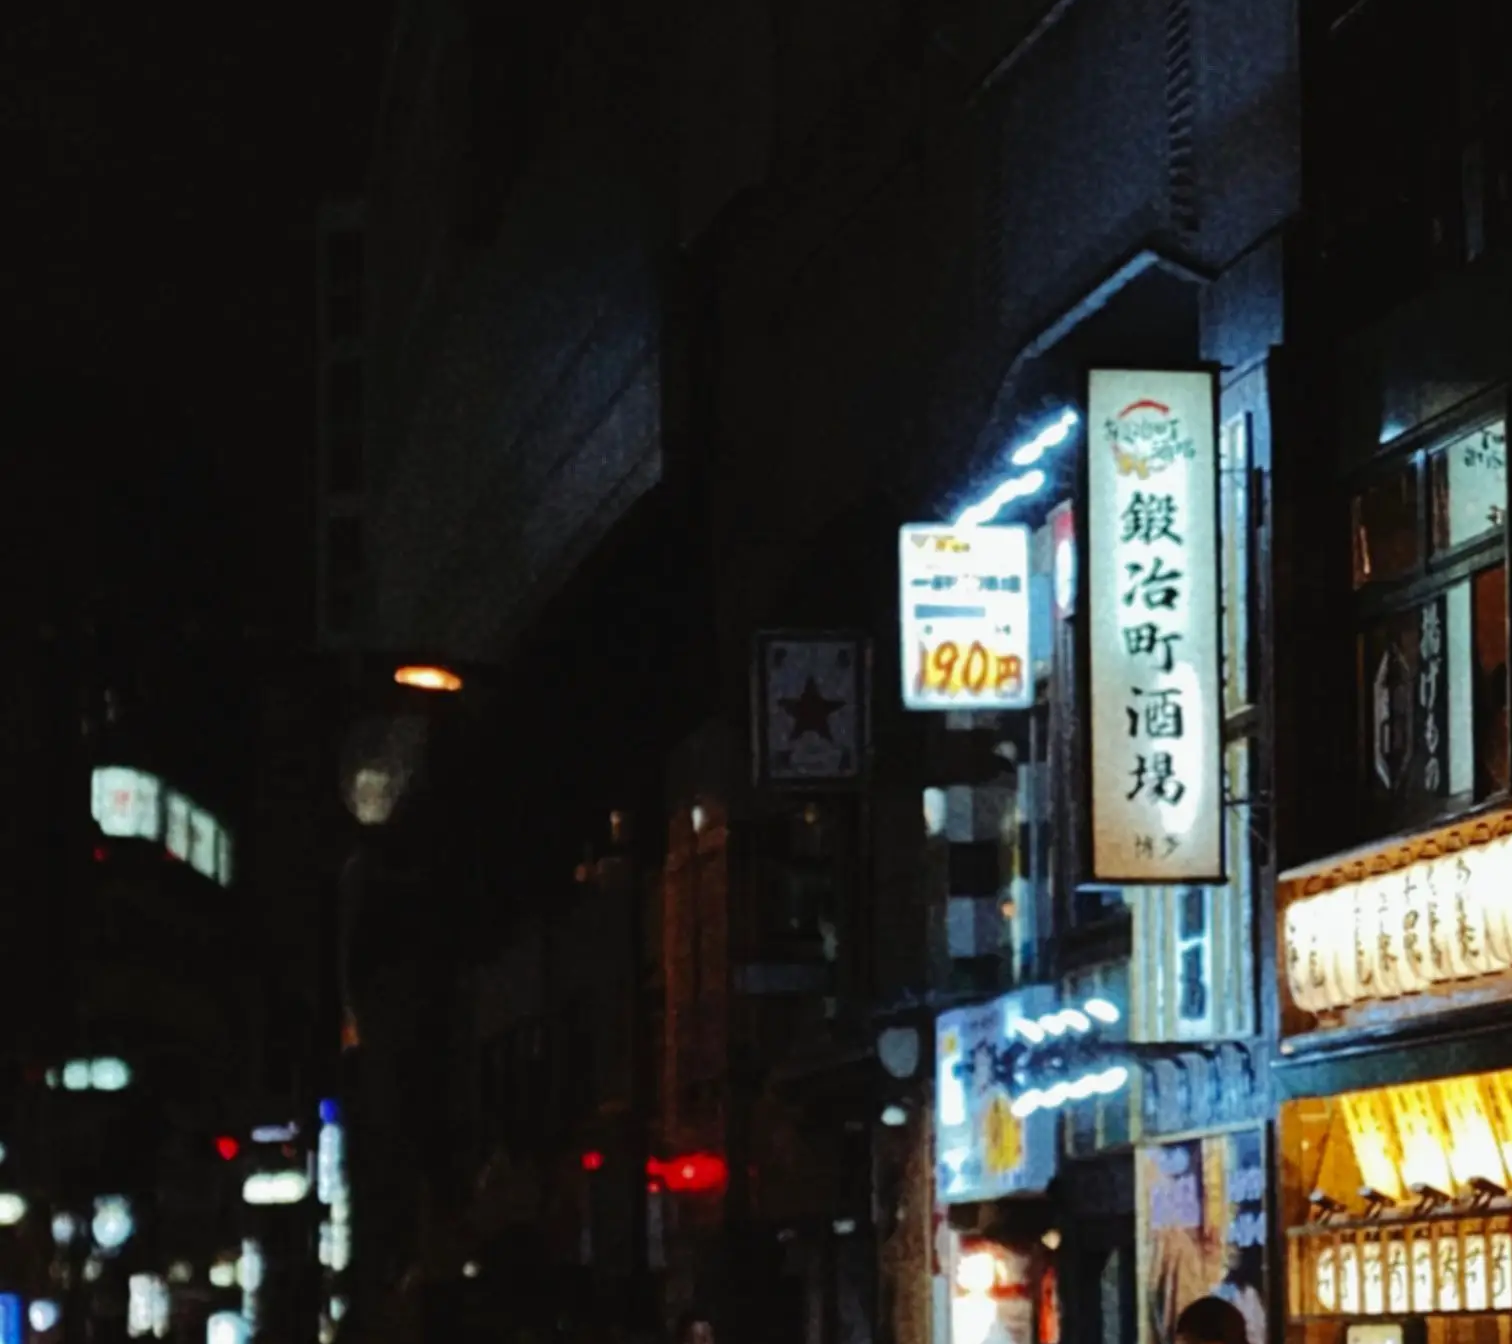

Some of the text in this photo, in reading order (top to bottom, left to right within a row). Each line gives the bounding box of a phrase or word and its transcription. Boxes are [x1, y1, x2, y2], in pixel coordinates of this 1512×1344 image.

[1120, 491, 1187, 807] 鍛冶町酒場
